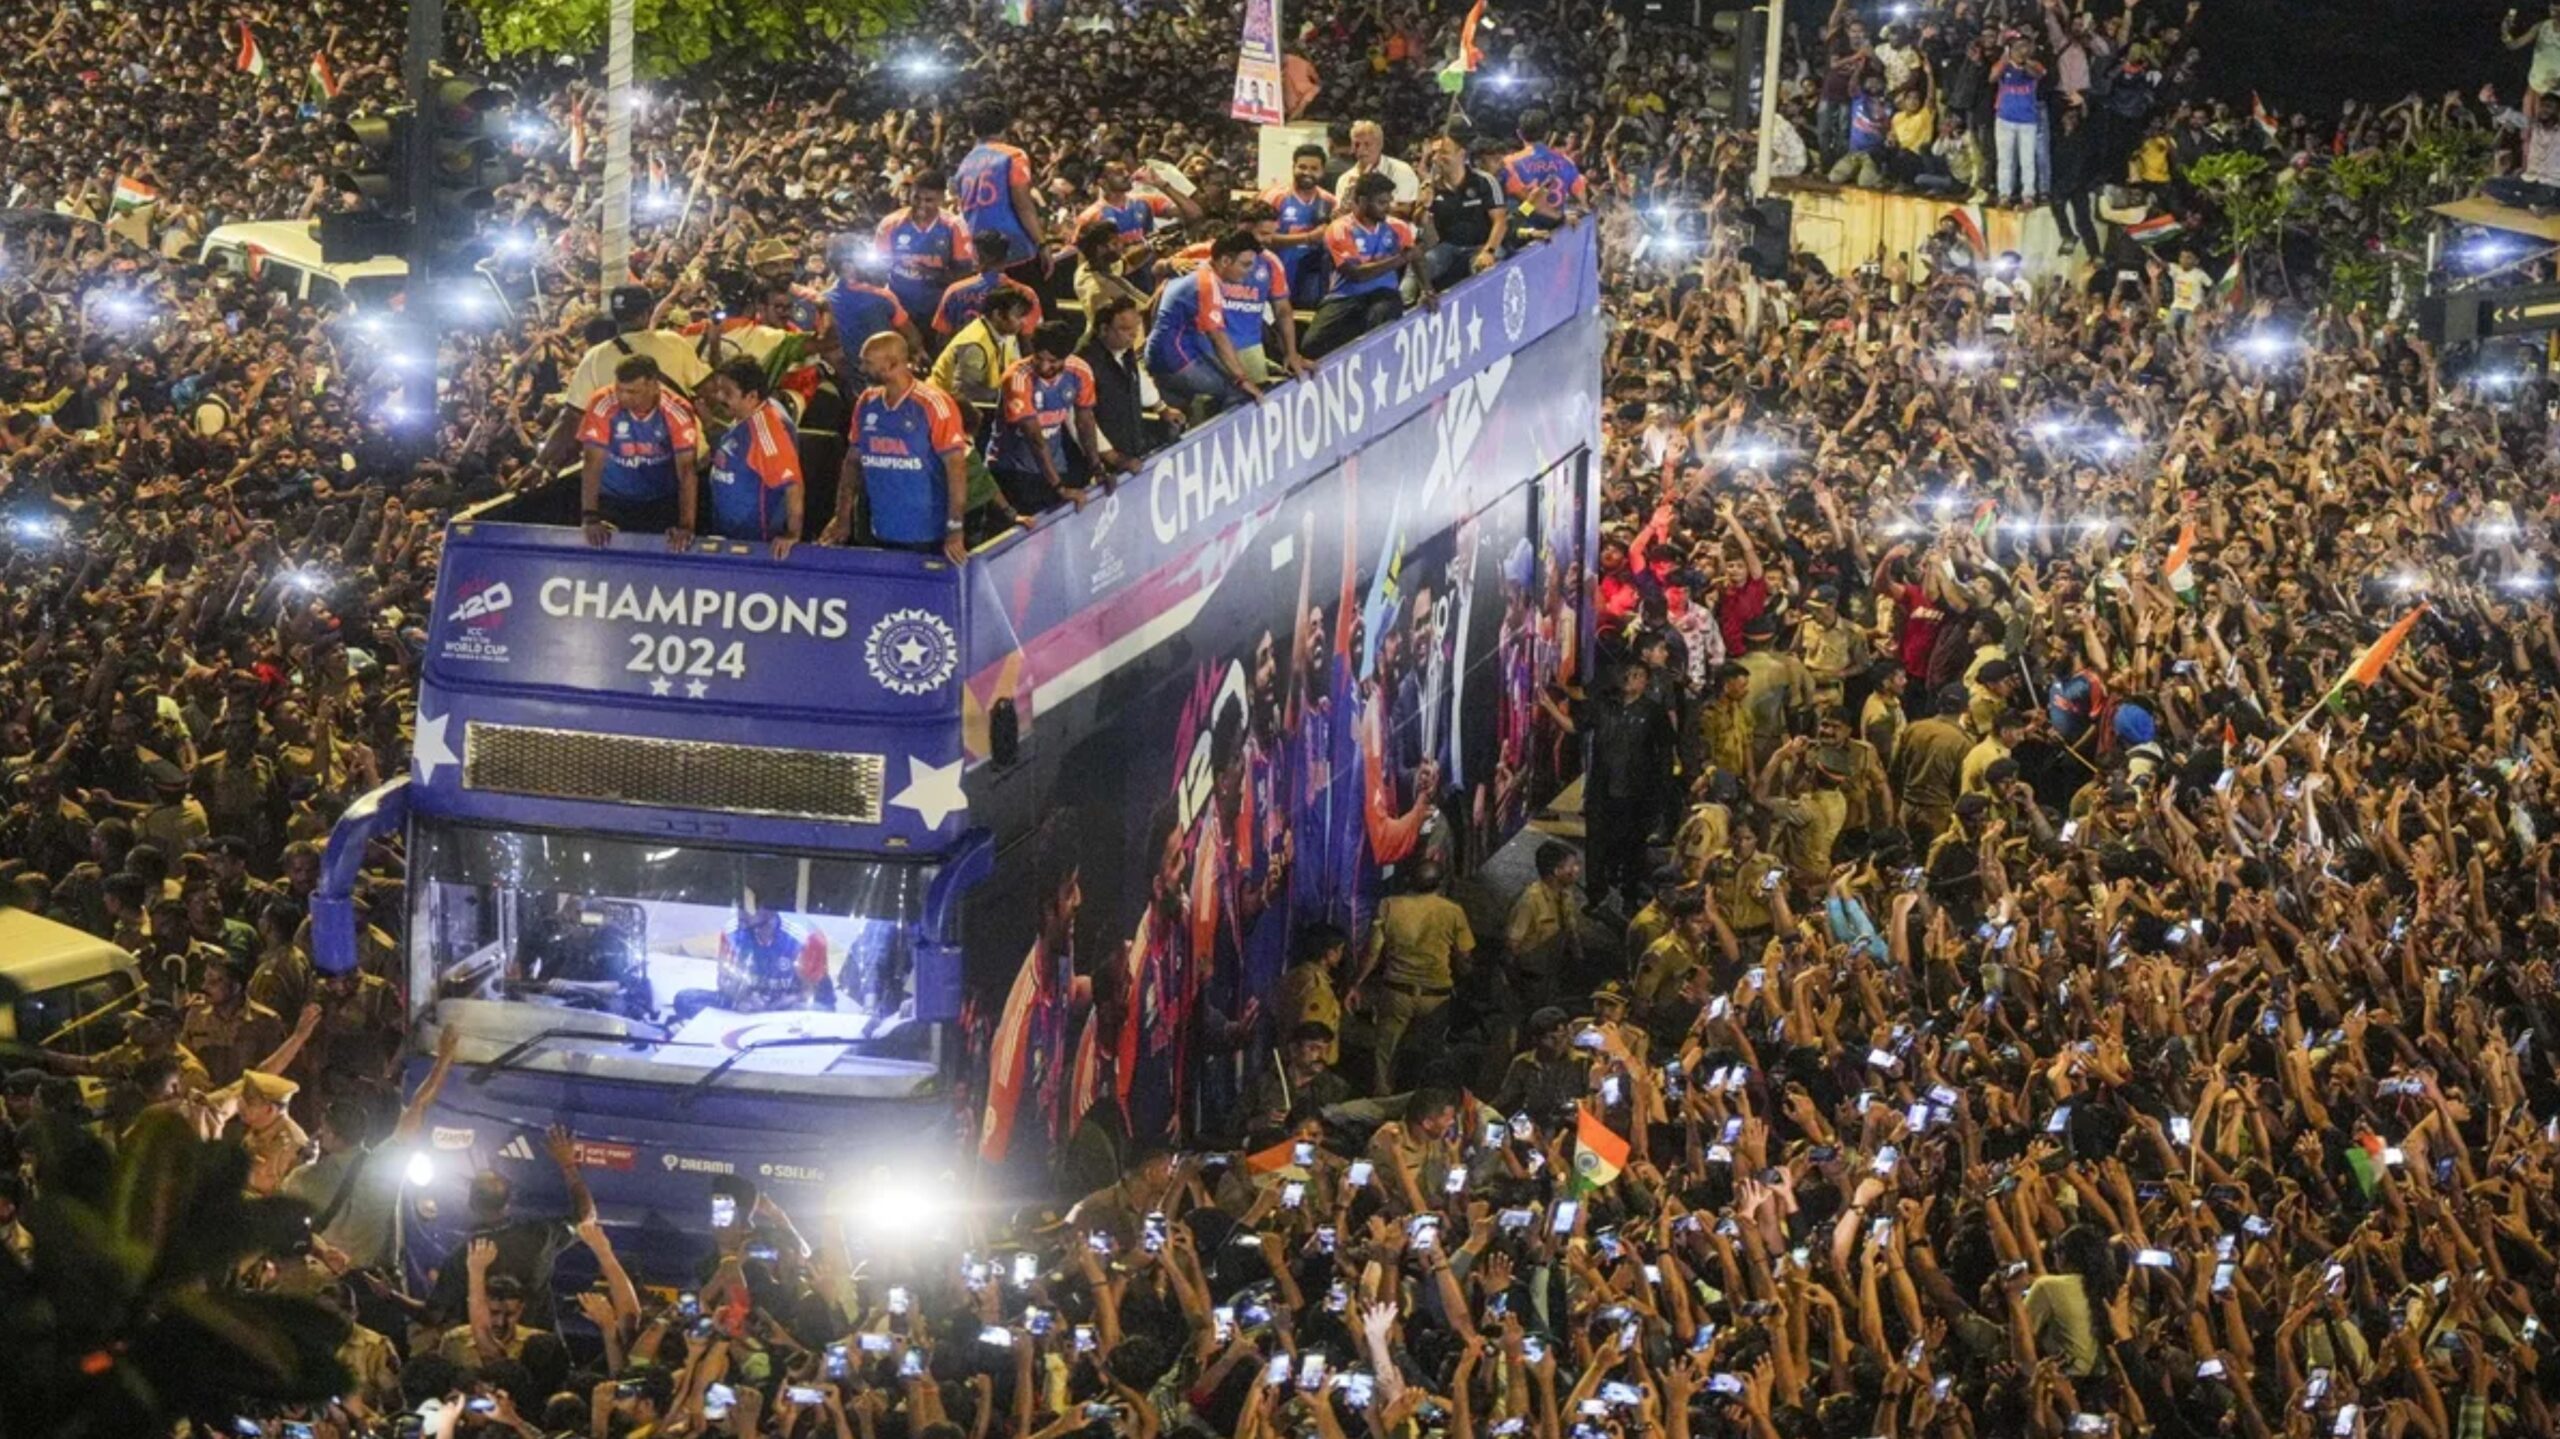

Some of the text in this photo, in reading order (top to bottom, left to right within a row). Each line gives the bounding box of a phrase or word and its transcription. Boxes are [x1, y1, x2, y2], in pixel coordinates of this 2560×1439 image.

[1150, 301, 1463, 545] CHAMPIONS 2024
[861, 455, 922, 471] CHAMPIONS
[539, 577, 848, 638] CHAMPIONS
[626, 633, 746, 679] 2024
